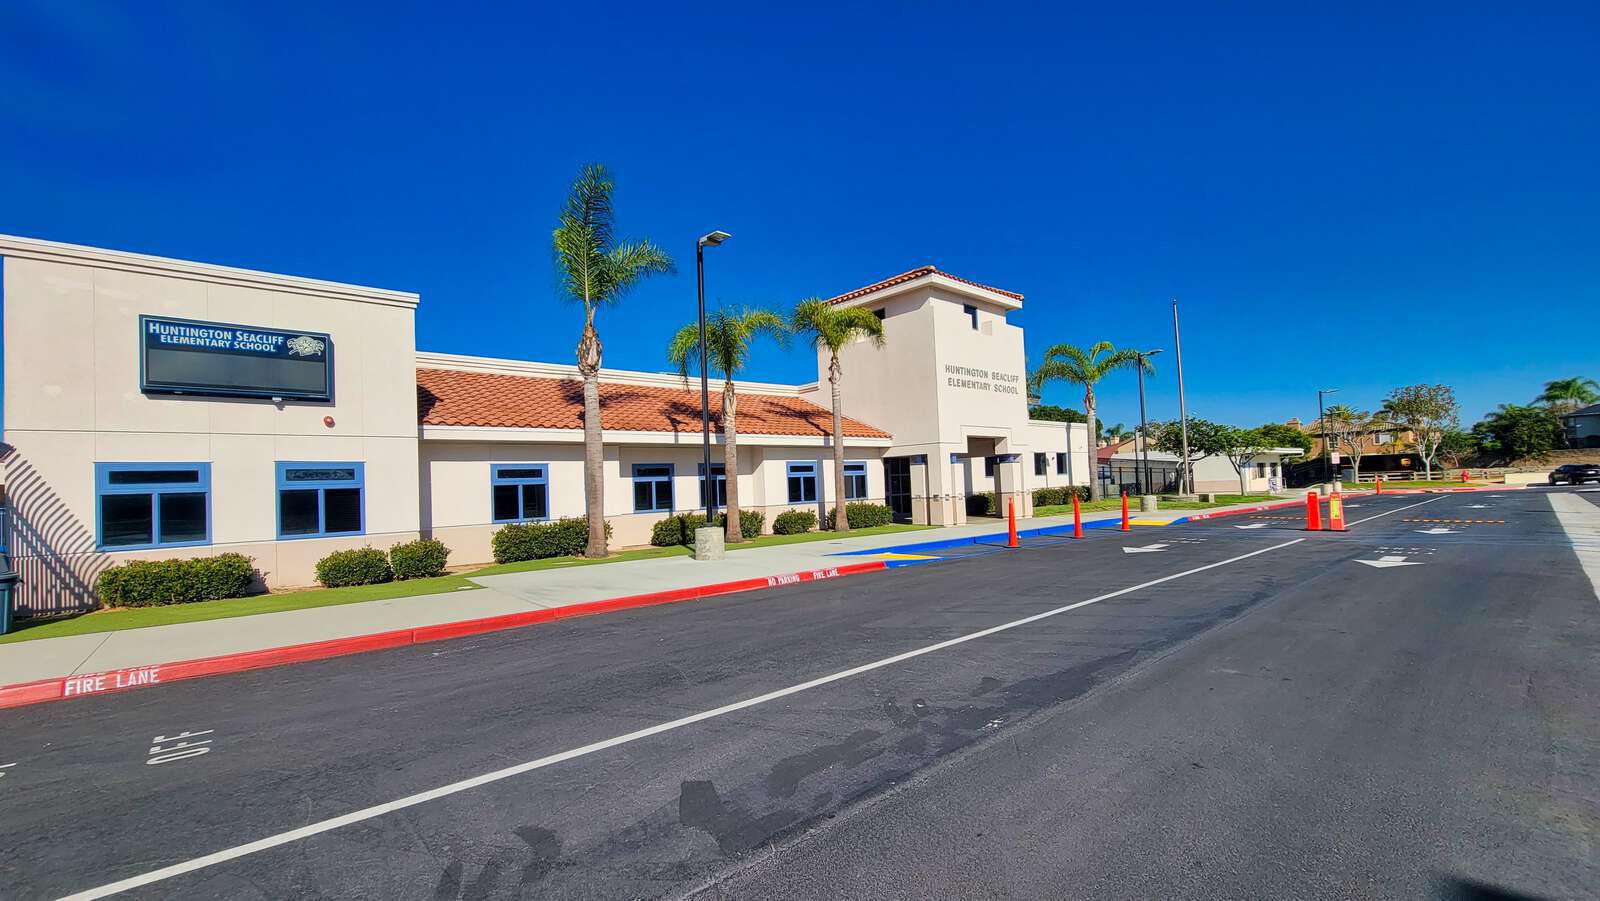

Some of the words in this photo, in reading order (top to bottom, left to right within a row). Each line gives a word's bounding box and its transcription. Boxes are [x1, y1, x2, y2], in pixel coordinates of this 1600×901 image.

[149, 322, 232, 340] HUNTINGTON
[235, 331, 284, 345] SEACLIFF
[160, 334, 231, 348] ELEMENTARY
[233, 341, 276, 352] SCHOOL
[945, 364, 989, 379] HUNTINGTON
[991, 371, 1019, 383] SEACLIFF
[947, 377, 991, 391] ELEMENTARY
[993, 384, 1019, 394] SCHOOL
[768, 576, 777, 587] NO
[778, 574, 800, 585] PARKING
[812, 570, 825, 580] FIRE
[826, 568, 840, 578] LANE
[64, 674, 107, 696] FIRE
[116, 668, 160, 688] LANE
